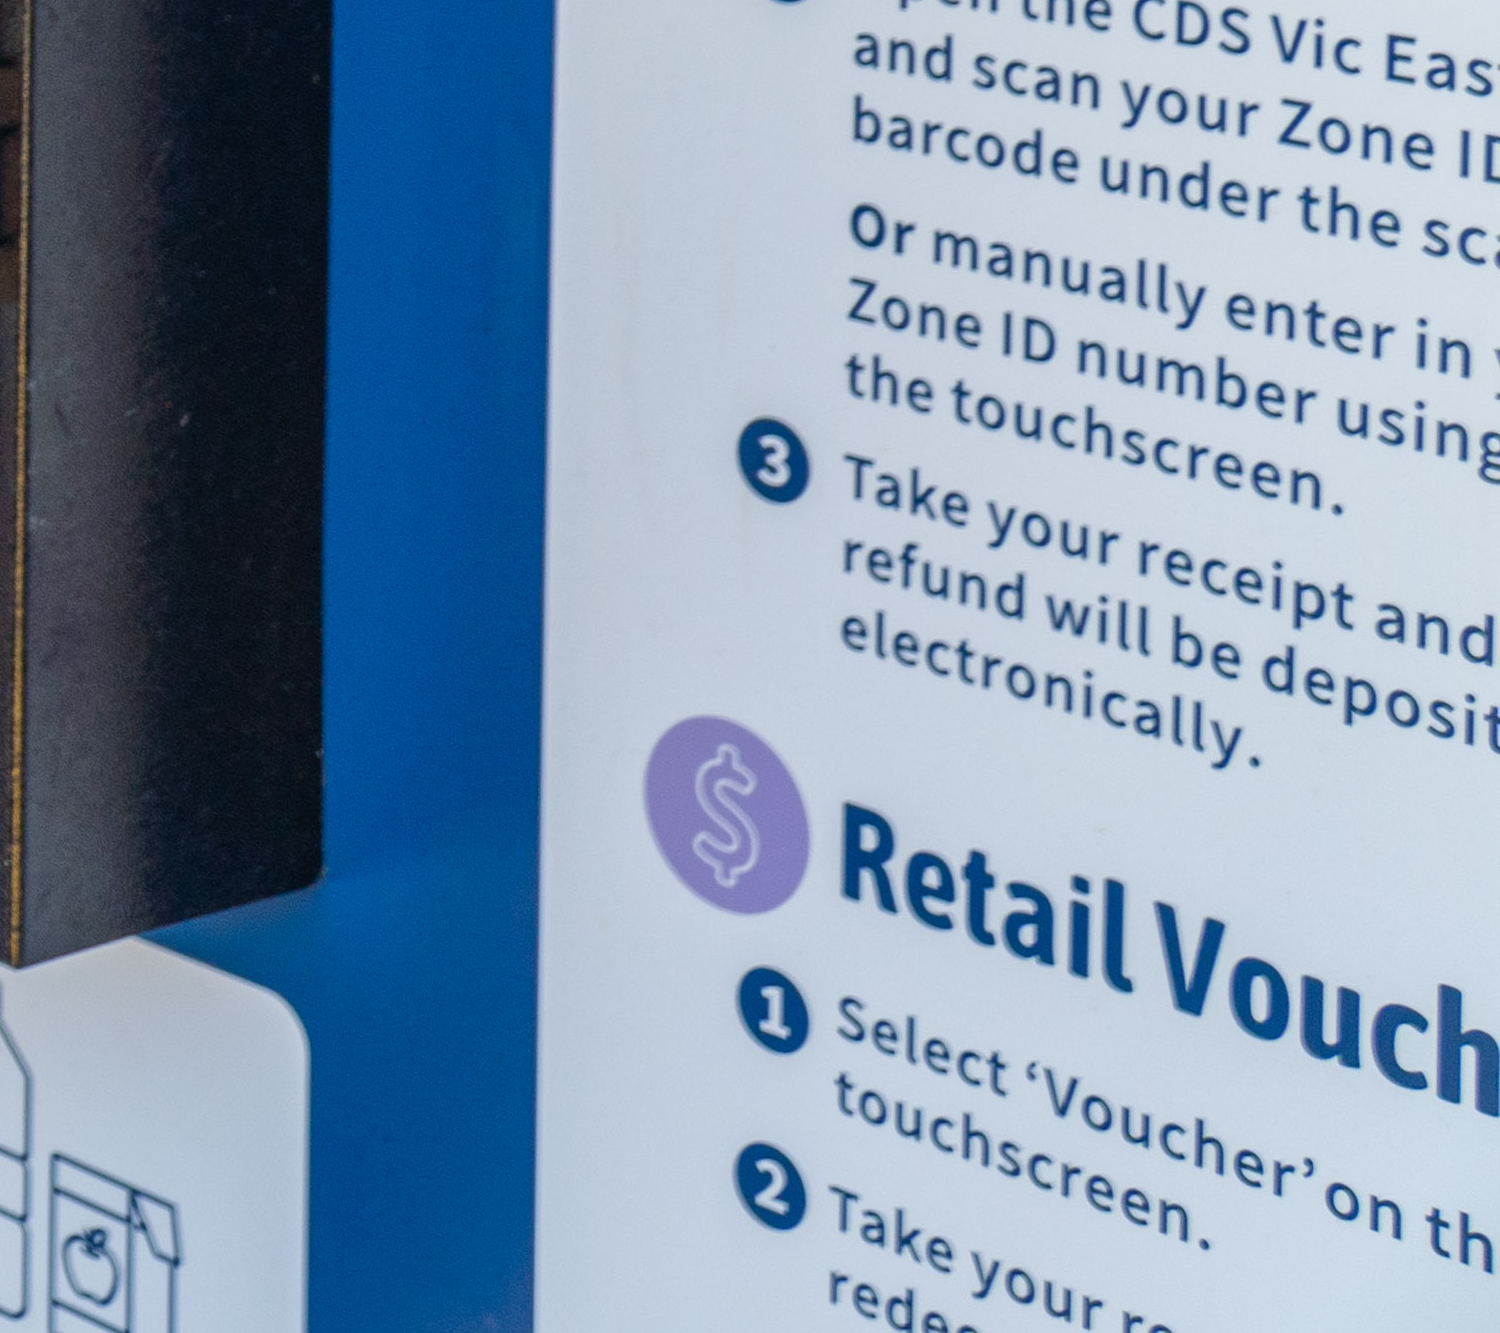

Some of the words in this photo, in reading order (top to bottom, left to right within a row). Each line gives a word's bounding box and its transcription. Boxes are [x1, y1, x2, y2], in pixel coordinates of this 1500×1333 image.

[853, 32, 953, 83] and
[972, 54, 1100, 110] scan
[1121, 80, 1260, 137] your
[1278, 97, 1435, 171] Zone
[1270, 14, 1361, 75] Vic
[1385, 33, 1493, 97] Eas
[853, 94, 1080, 184] barcode
[1100, 156, 1281, 223] under
[1297, 185, 1401, 248] the
[1422, 219, 1500, 270] sc
[847, 277, 982, 349] Zone
[1002, 311, 1056, 363] ID
[1077, 340, 1318, 424] number
[849, 203, 916, 255] Or
[933, 230, 1207, 331] manually
[1225, 293, 1396, 360] enter
[1416, 317, 1471, 379] in
[844, 354, 934, 414] the
[950, 368, 1344, 516] touchscreen.
[756, 432, 792, 488] 3
[843, 453, 970, 528] Take
[987, 501, 1120, 566] your
[1138, 541, 1354, 642] receipt
[1375, 603, 1495, 667] and
[843, 540, 1025, 621] refund
[1045, 594, 1151, 657] will
[1171, 614, 1242, 680] be
[840, 601, 1261, 771] electronically.
[841, 802, 1134, 994] Retail
[1154, 901, 1500, 1118] Vouch
[758, 984, 790, 1036] 1
[834, 996, 1007, 1110] Select
[1325, 1182, 1402, 1241] on
[1425, 1207, 1494, 1275] th
[828, 1059, 1210, 1262] touchscreen.
[754, 1157, 790, 1216] 2
[828, 1185, 954, 1274] Take
[970, 1251, 1104, 1331] your
